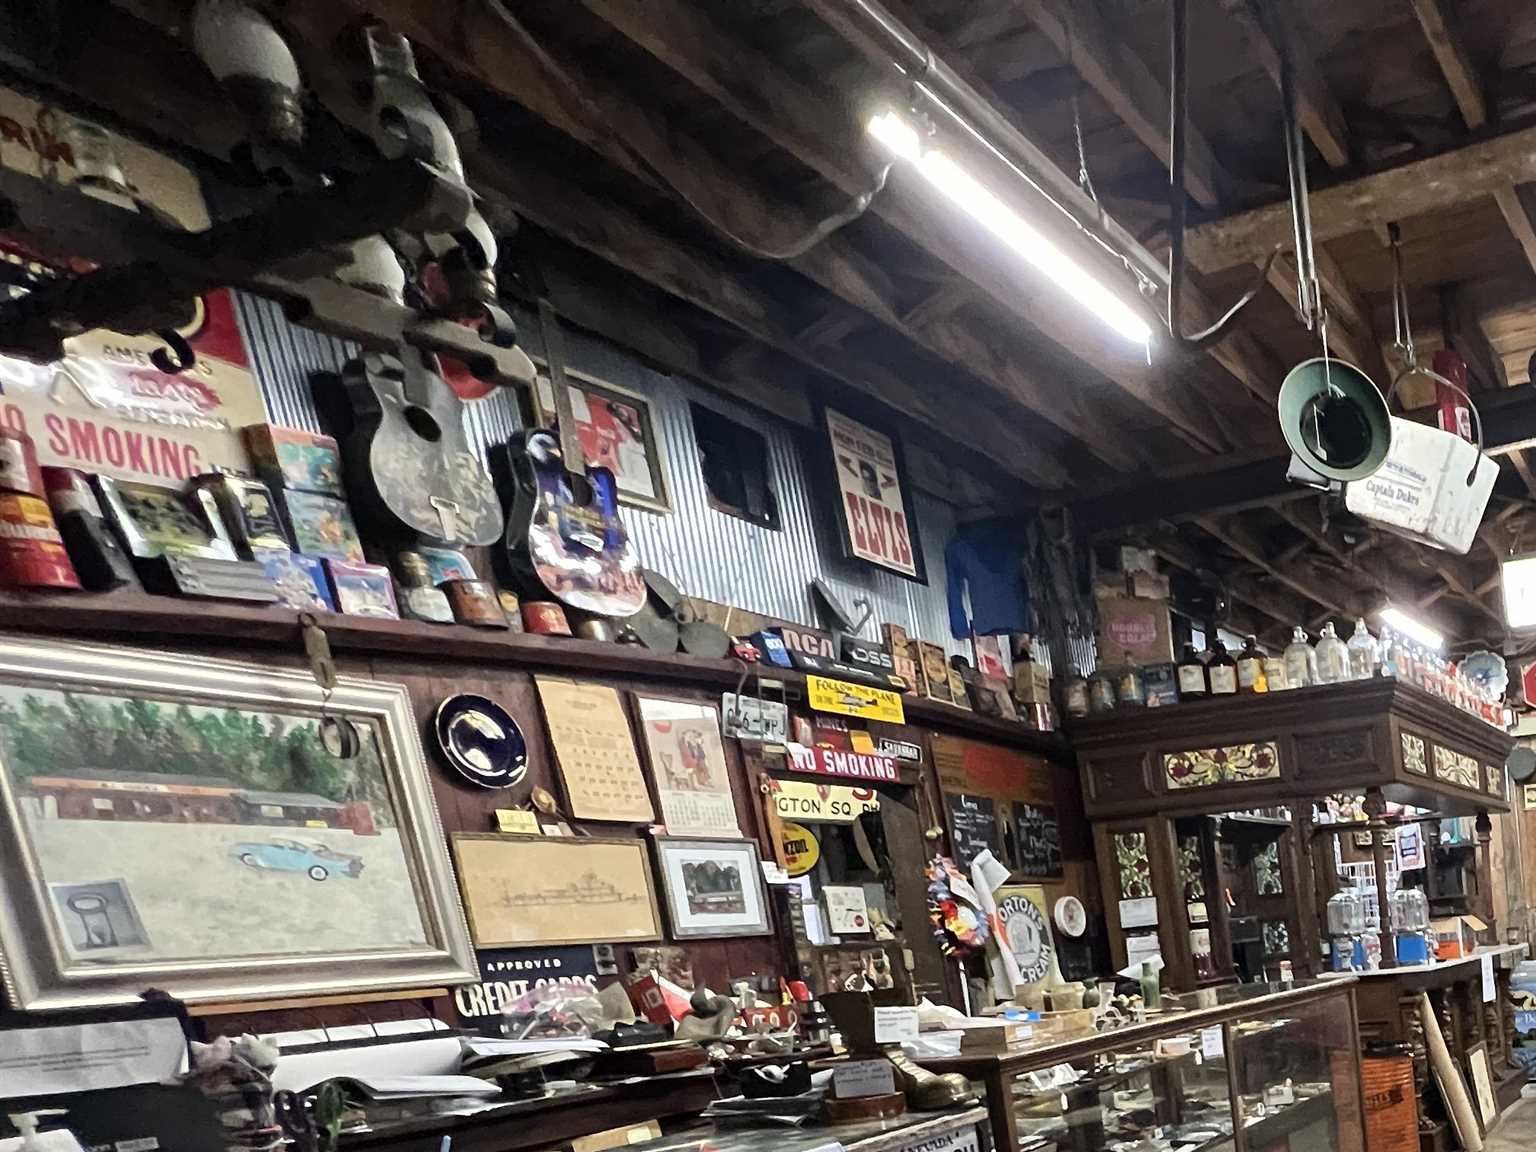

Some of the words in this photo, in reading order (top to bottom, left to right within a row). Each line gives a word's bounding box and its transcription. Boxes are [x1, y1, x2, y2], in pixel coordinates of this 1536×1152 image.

[44, 412, 201, 481] SMOKING
[846, 491, 913, 568] ELVIS
[815, 679, 853, 694] FOLLOW
[823, 750, 897, 779] SMOKING
[777, 797, 821, 814] GTON
[487, 957, 562, 972] APPROVED
[455, 980, 530, 1018] CREDIT
